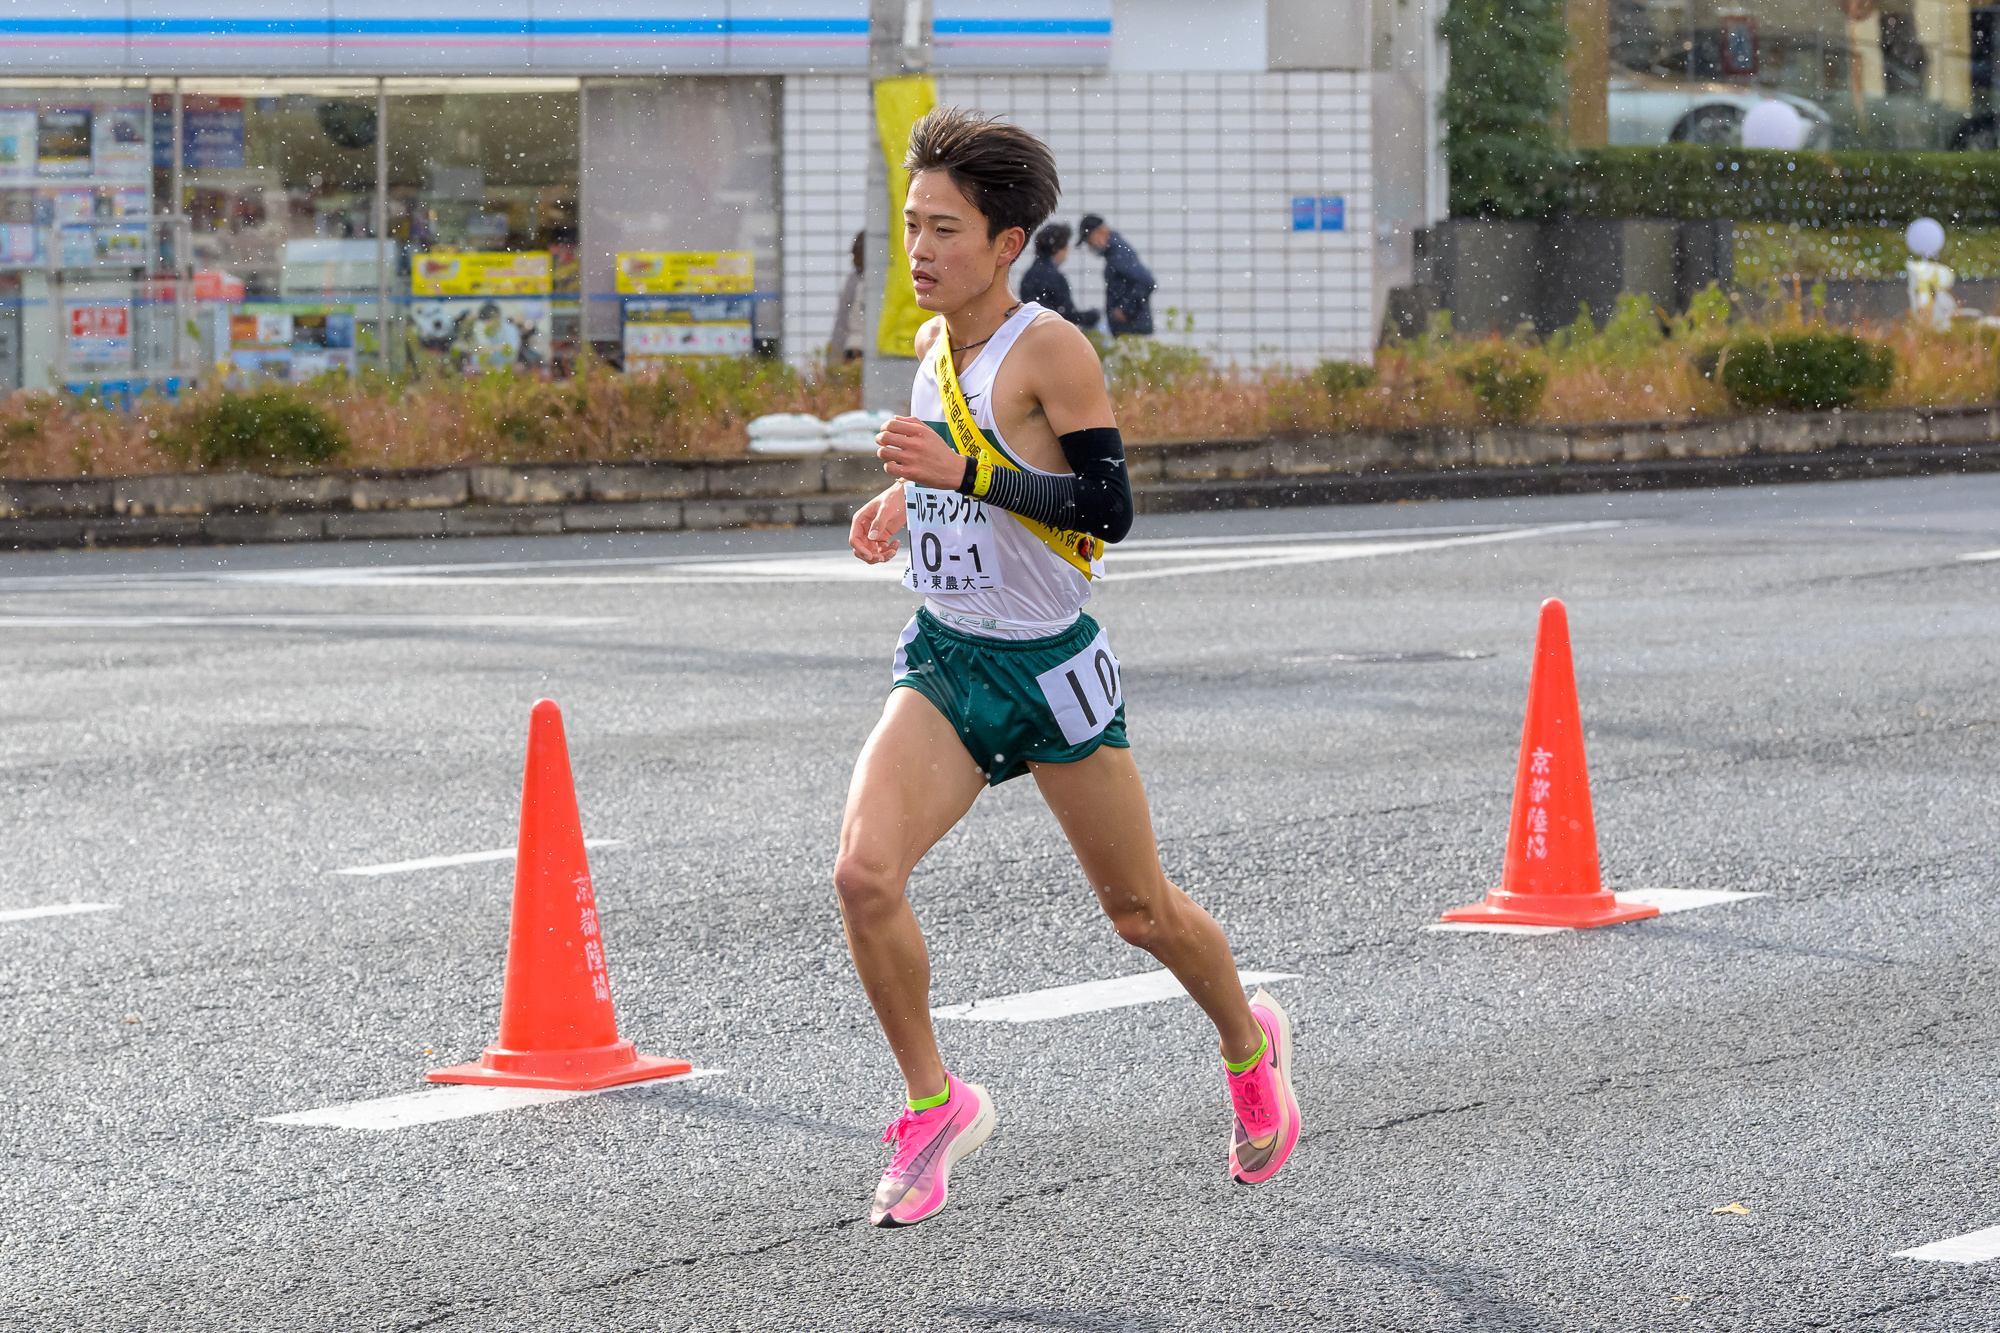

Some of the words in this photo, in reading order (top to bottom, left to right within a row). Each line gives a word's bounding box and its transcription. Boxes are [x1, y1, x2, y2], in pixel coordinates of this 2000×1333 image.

[1065, 649, 1117, 728] 10
[1526, 746, 1554, 860] 京都陸協
